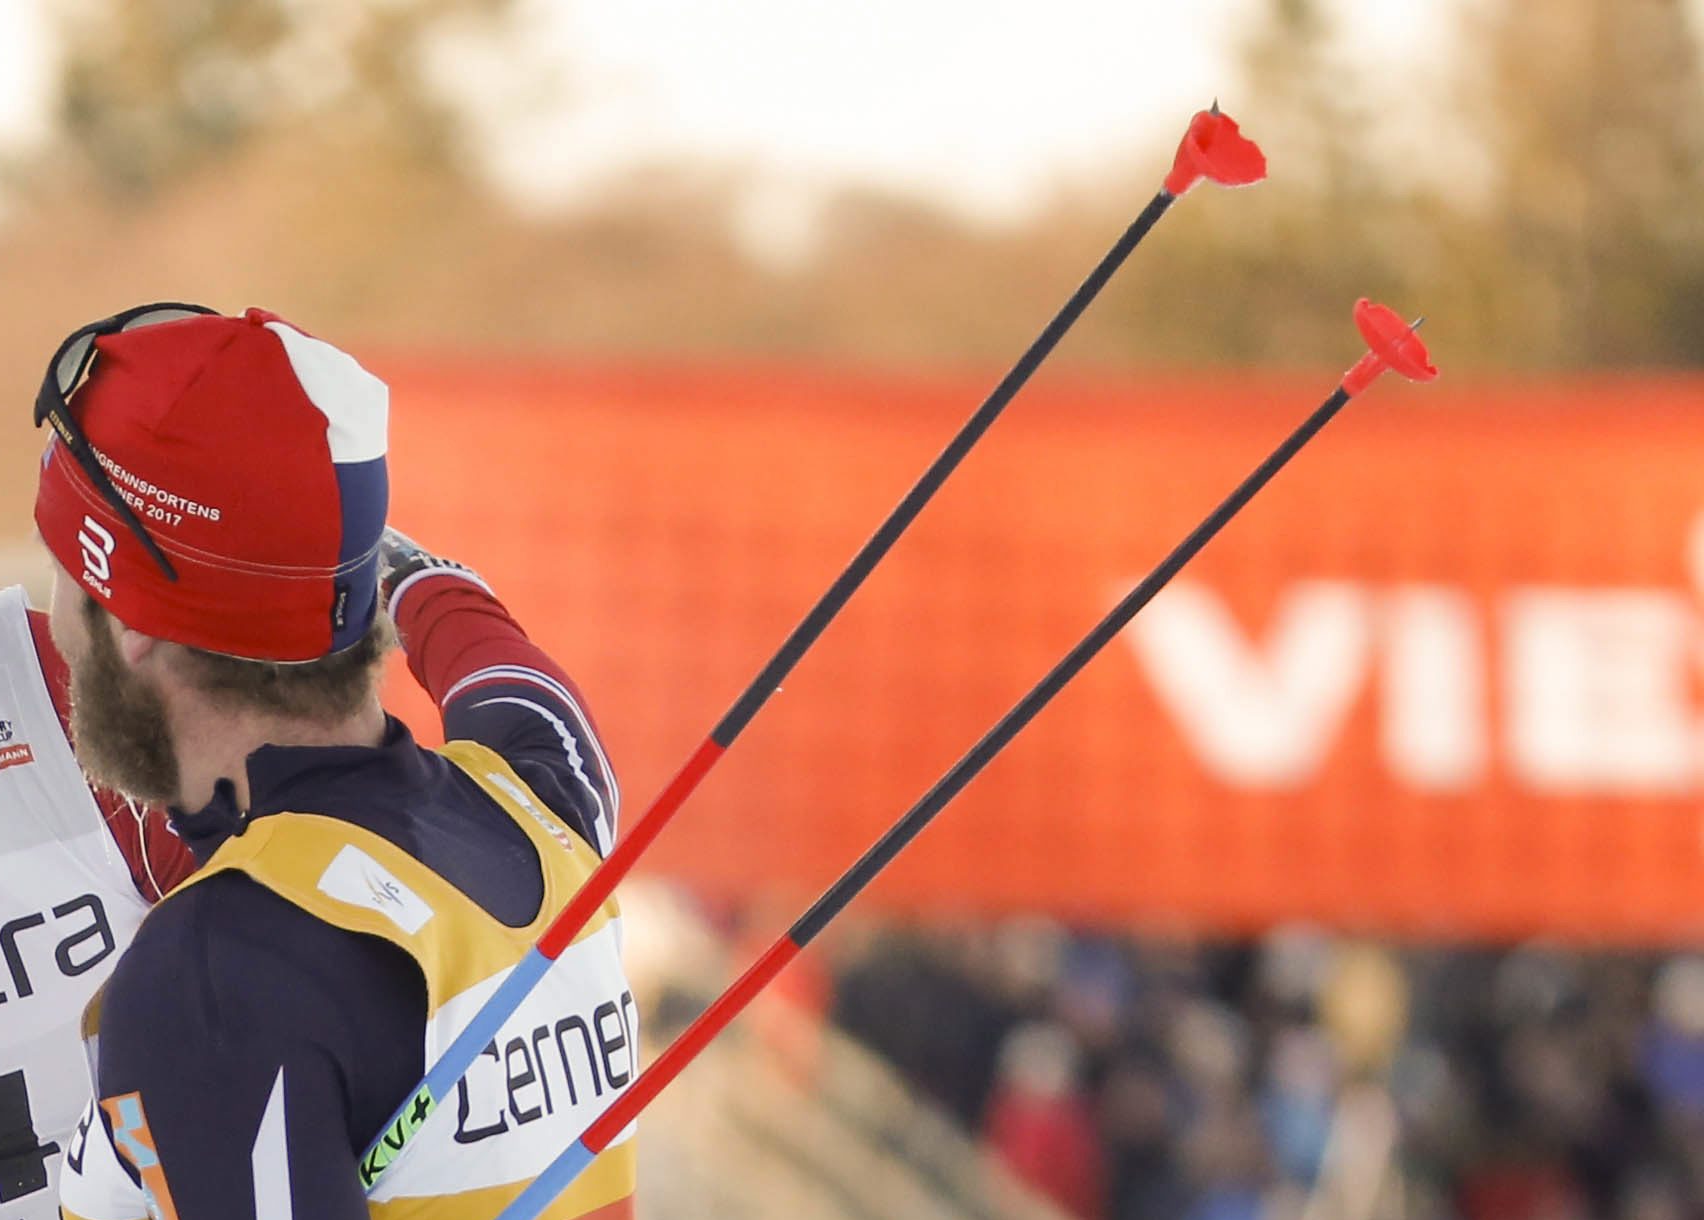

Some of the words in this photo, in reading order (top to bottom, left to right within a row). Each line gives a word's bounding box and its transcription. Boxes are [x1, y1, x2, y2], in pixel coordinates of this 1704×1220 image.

[89, 444, 221, 521] NGRENNSPORTENS
[146, 503, 182, 527] 2017
[1111, 572, 1704, 797] VIE
[360, 1093, 433, 1186] KV+
